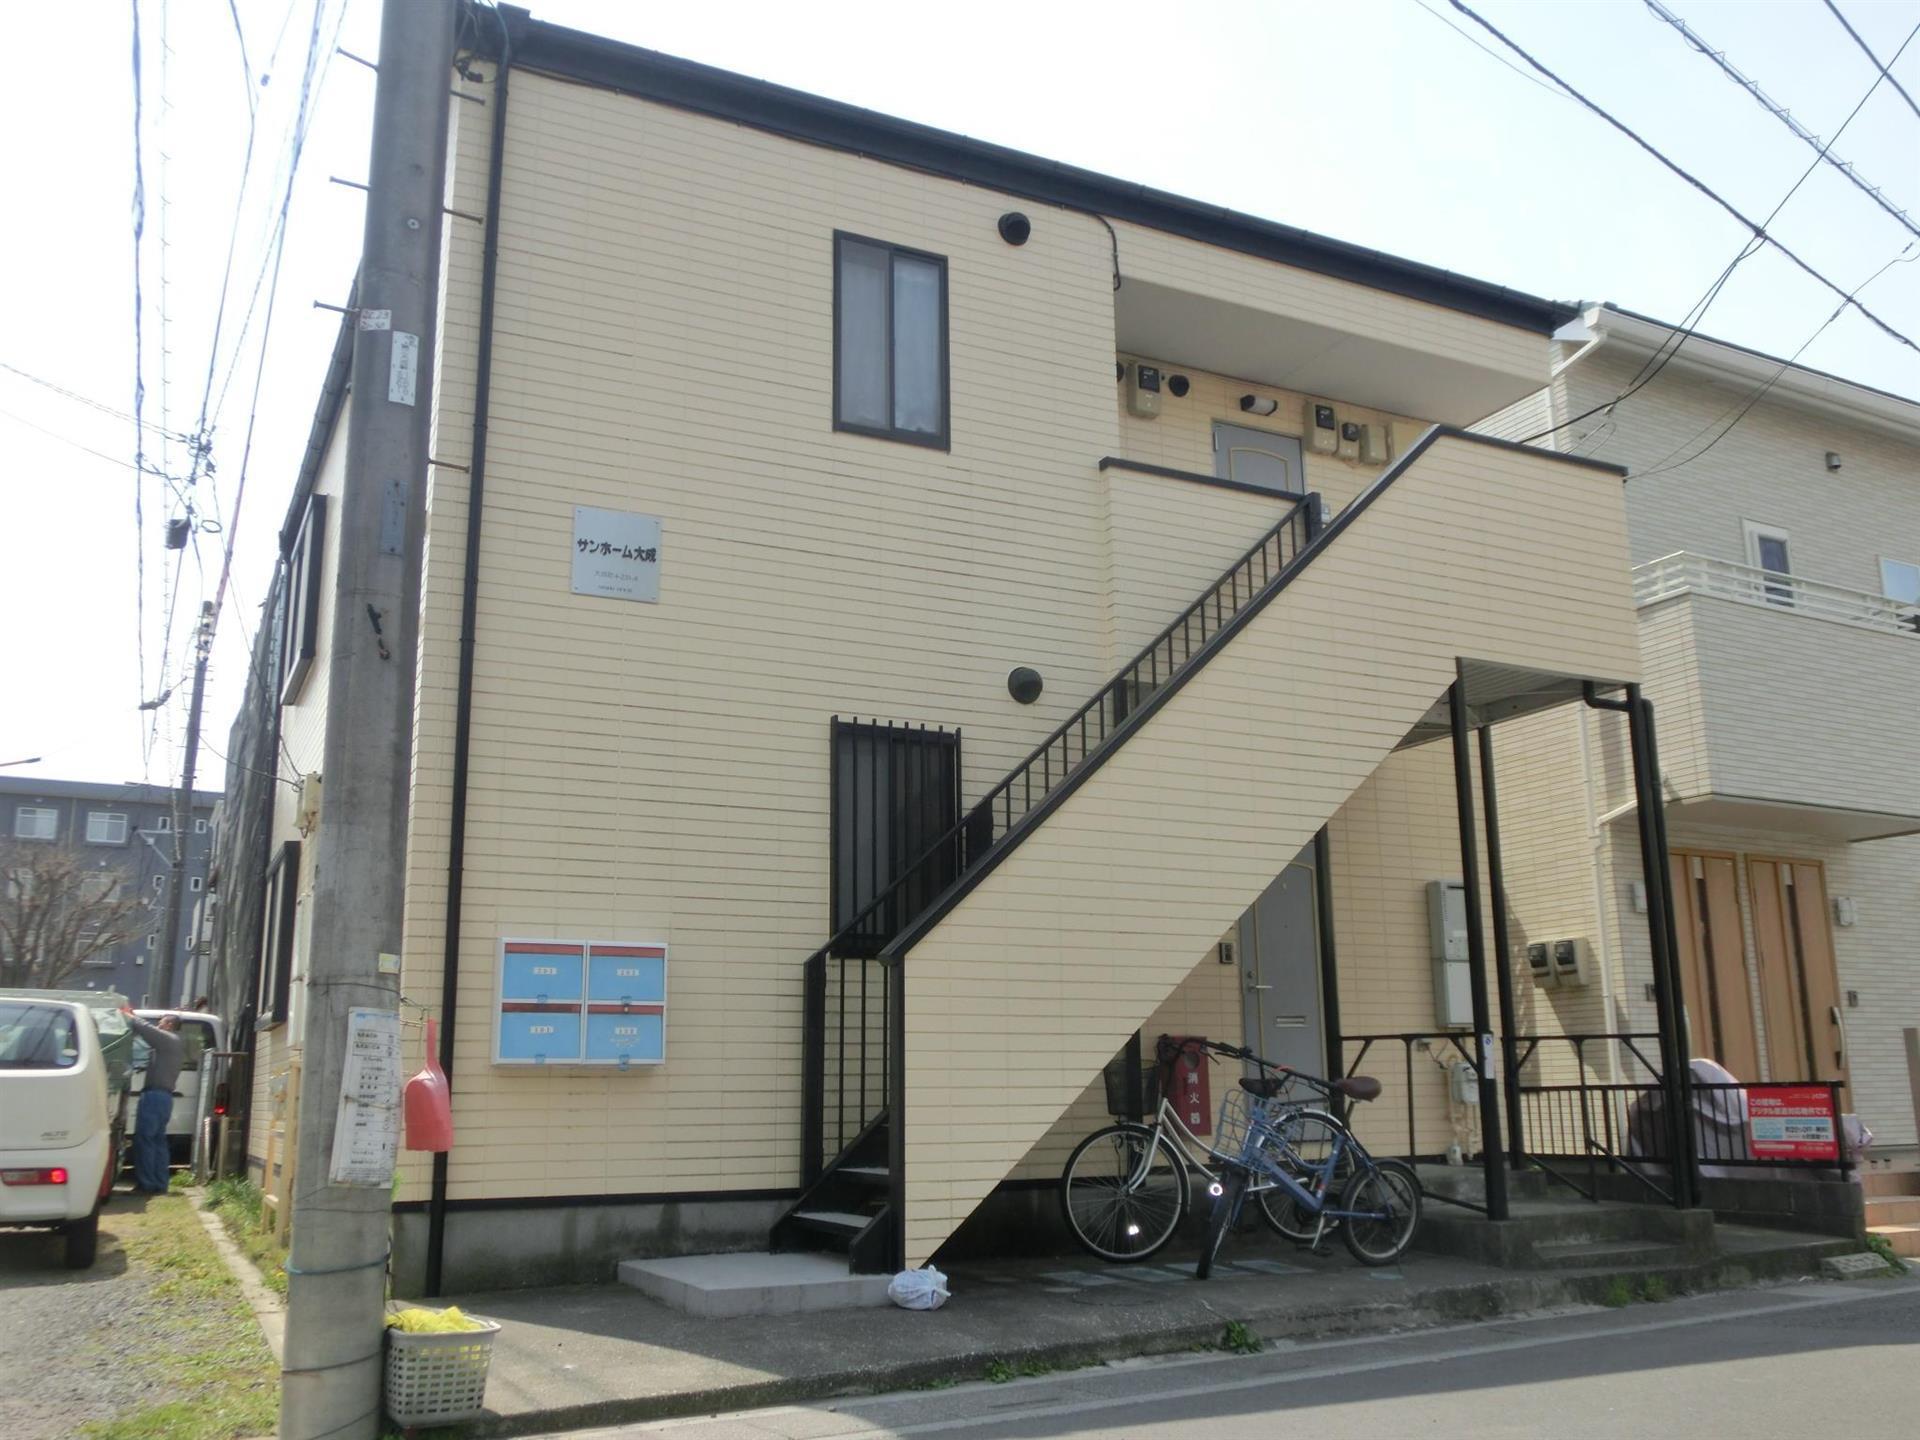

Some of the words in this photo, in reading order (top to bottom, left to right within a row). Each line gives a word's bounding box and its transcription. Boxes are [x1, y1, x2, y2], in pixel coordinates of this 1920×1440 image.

[577, 537, 657, 563] サンホーム大成
